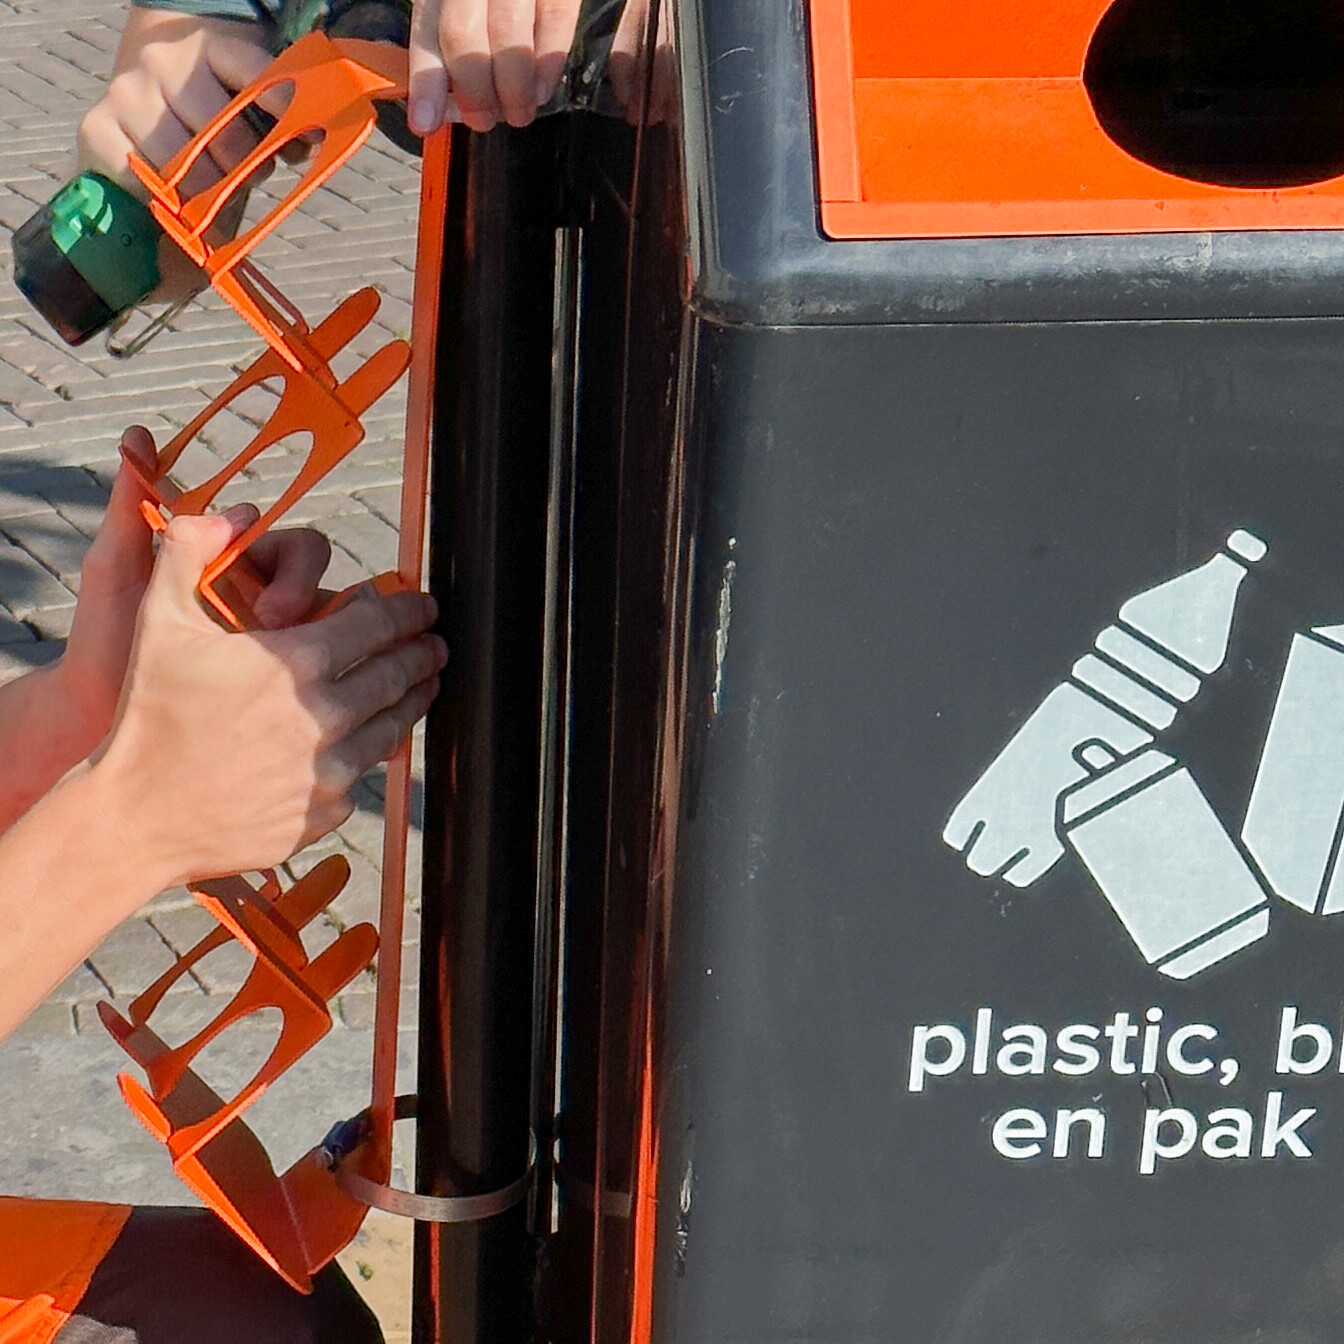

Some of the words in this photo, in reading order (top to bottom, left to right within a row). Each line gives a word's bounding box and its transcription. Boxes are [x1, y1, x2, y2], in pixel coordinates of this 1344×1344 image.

[908, 1006, 1239, 1092] plastic,
[992, 1107, 1106, 1159] en
[1139, 1091, 1317, 1175] pak
